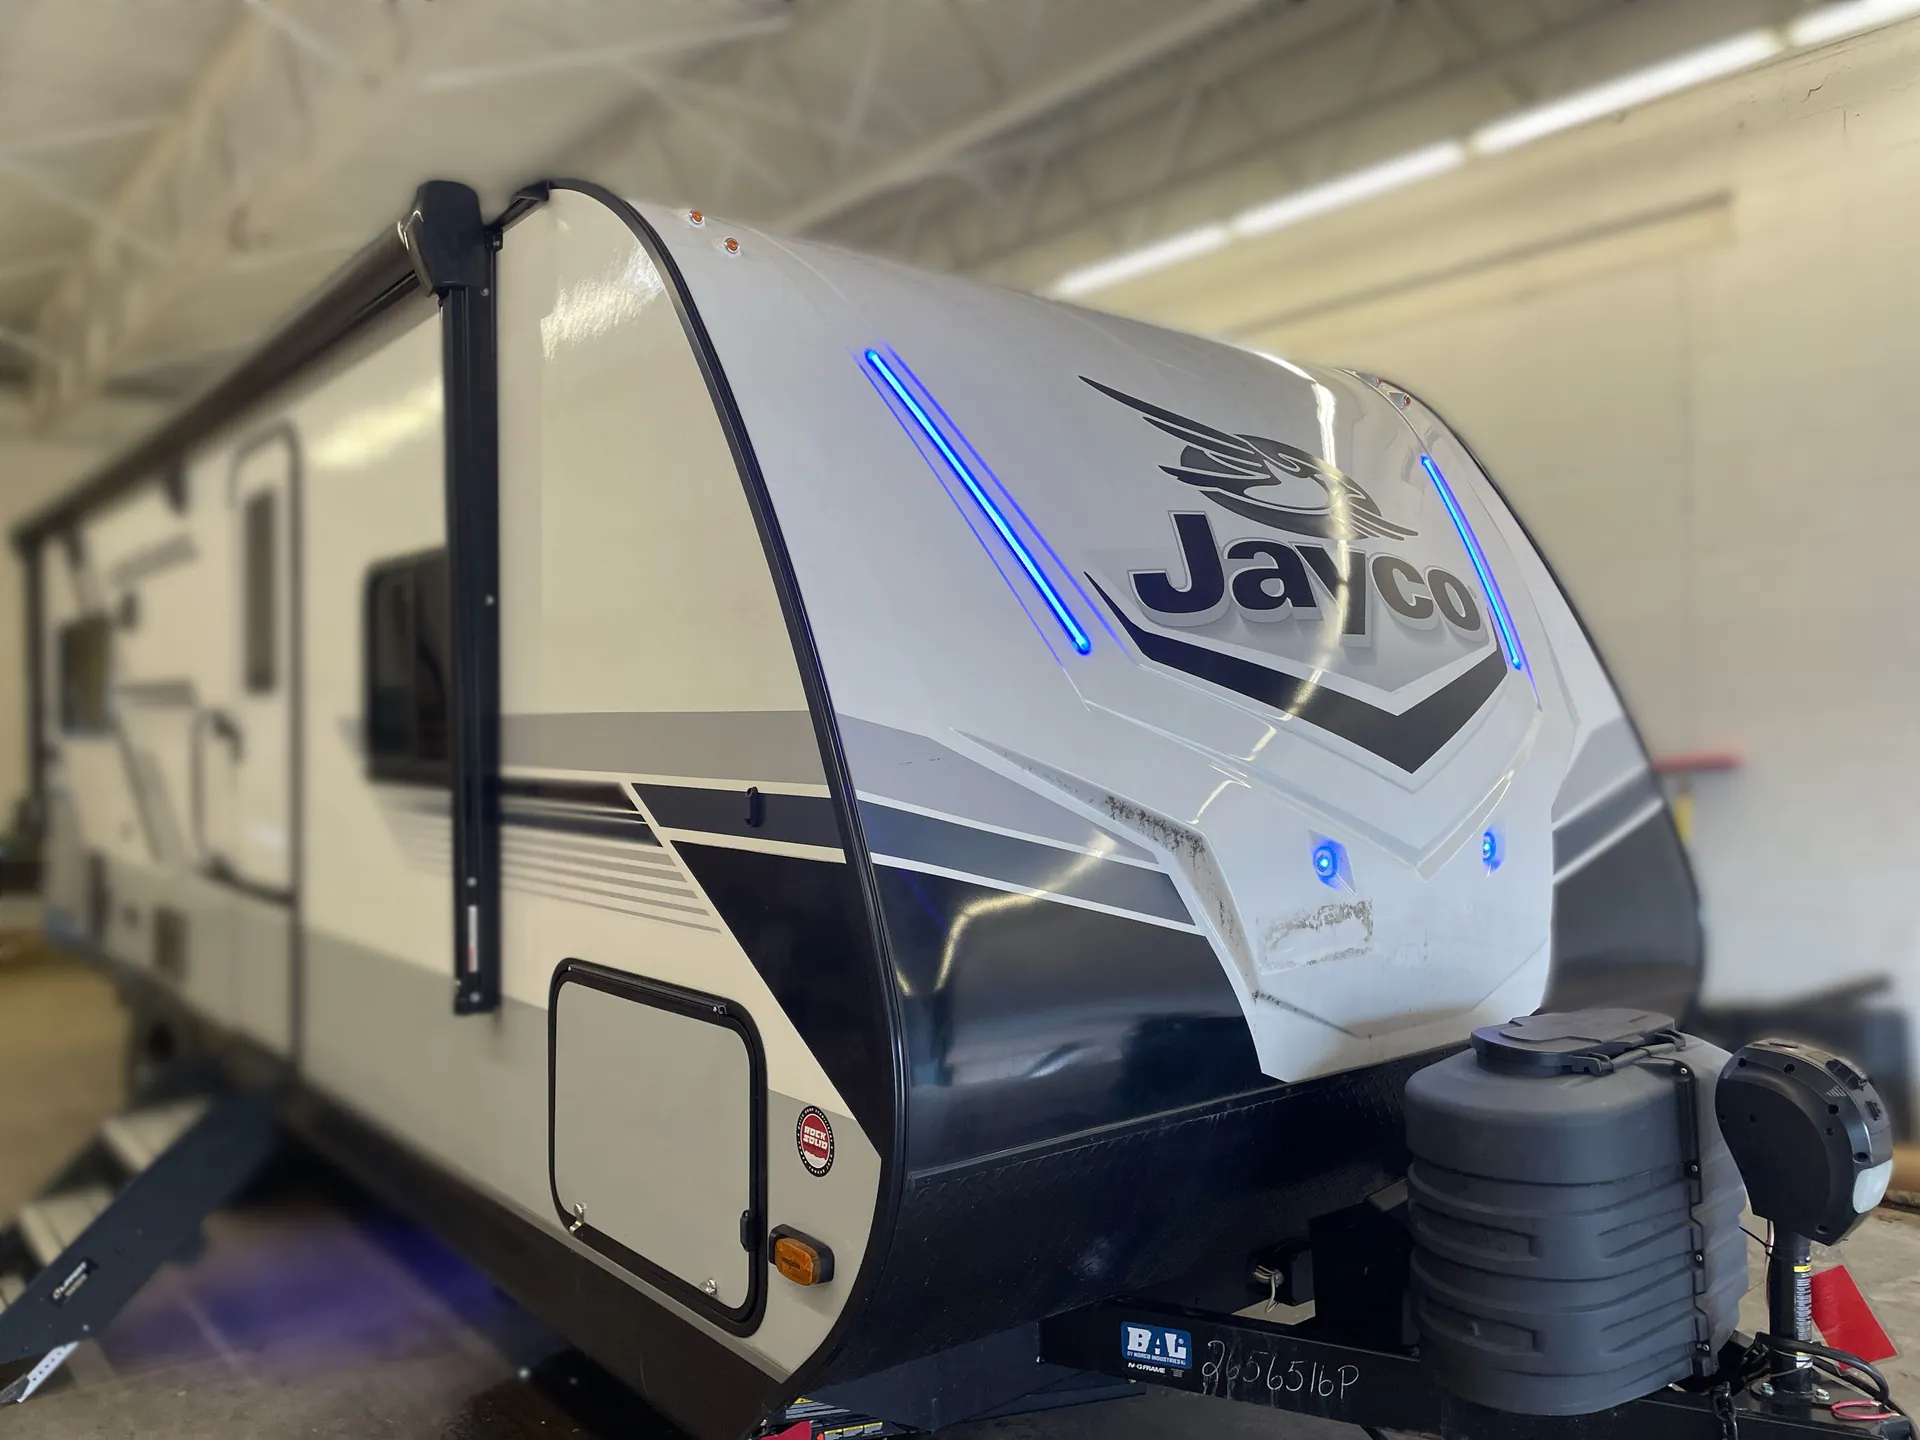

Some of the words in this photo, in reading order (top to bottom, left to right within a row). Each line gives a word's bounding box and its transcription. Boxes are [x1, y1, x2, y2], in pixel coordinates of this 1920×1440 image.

[1130, 511, 1486, 640] Jayco
[804, 1125, 826, 1140] ROCK
[803, 1134, 827, 1149] SOLID
